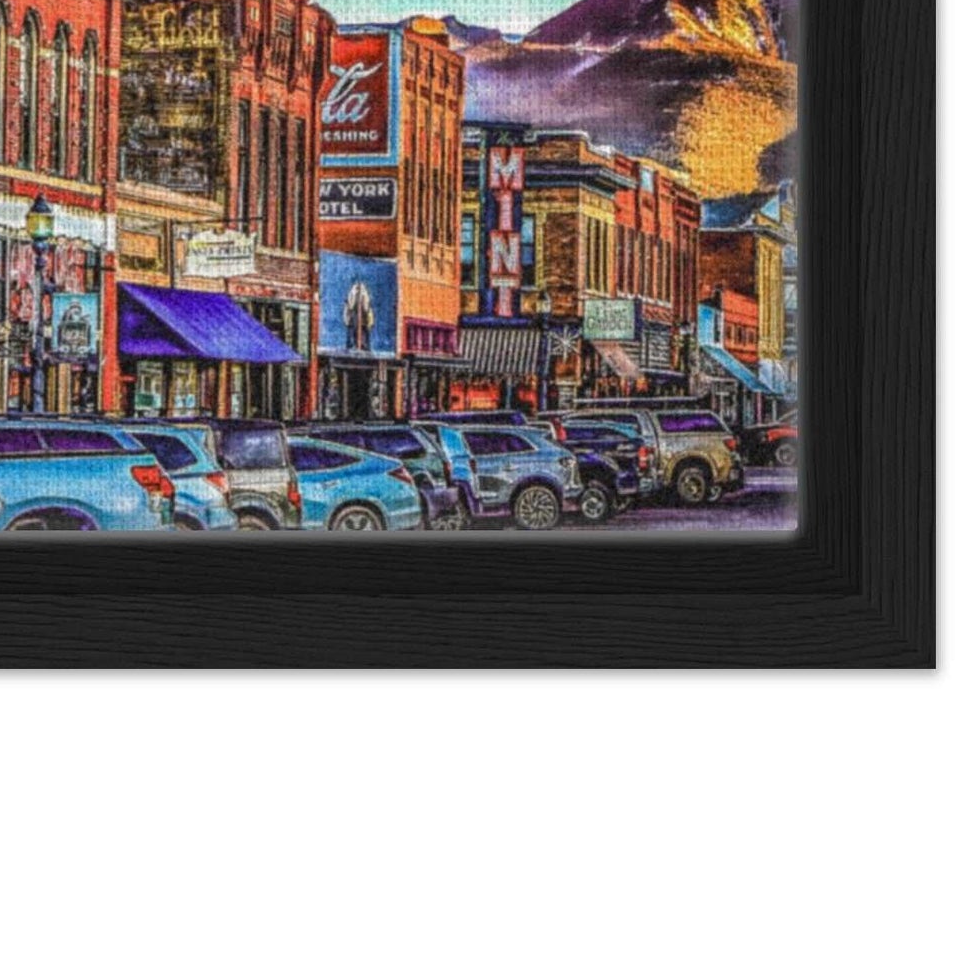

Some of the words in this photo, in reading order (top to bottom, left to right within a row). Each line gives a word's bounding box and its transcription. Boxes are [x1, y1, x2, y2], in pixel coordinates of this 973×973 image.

[338, 183, 391, 198] YORK
[320, 201, 364, 215] OTEL
[489, 146, 525, 318] MINT
